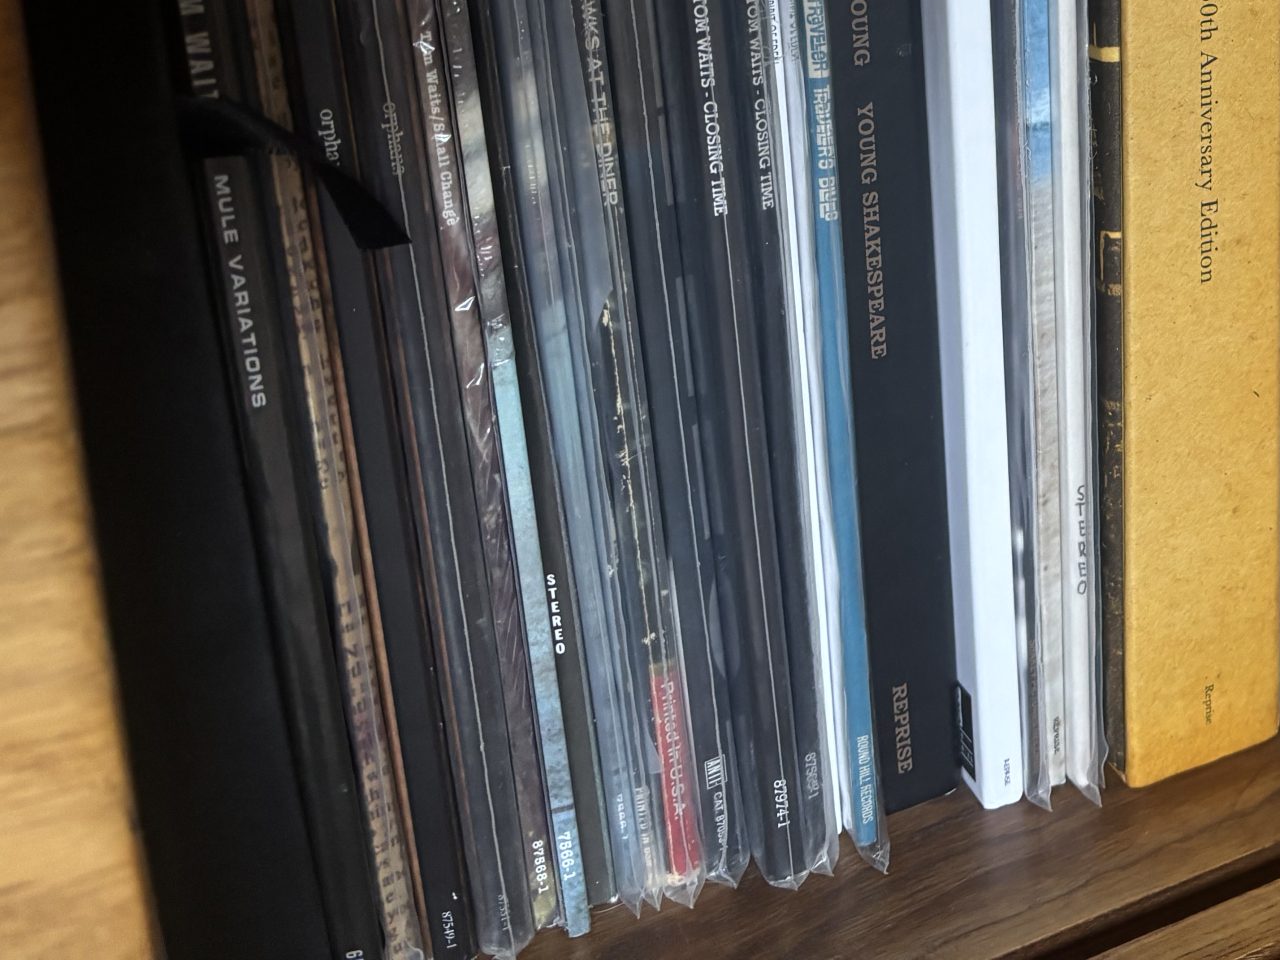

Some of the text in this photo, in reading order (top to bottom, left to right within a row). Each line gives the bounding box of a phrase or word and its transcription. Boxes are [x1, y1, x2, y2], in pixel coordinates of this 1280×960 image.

[588, 58, 606, 86] AT
[695, 36, 715, 87] WAITS
[748, 38, 764, 84] WAITS
[592, 91, 611, 138] THE
[702, 101, 723, 174] CLOSING
[754, 98, 771, 168] CLOSING
[1193, 50, 1219, 191] Anniversary
[598, 141, 619, 207] DINER
[711, 178, 728, 216] TIME
[761, 171, 775, 210] TIME
[855, 102, 888, 360] YOUNG SHAKESPEARE
[1197, 199, 1220, 284] Edition
[213, 174, 267, 409] MULE VARIATIONS
[1076, 484, 1087, 595] STEREO
[546, 574, 566, 655] STEREO
[659, 676, 681, 738] Printed
[892, 683, 914, 774] REPRISE
[1199, 683, 1215, 725] Reprise
[773, 778, 791, 829] 87974-1
[856, 734, 874, 824] ROUND HILL RECORDS
